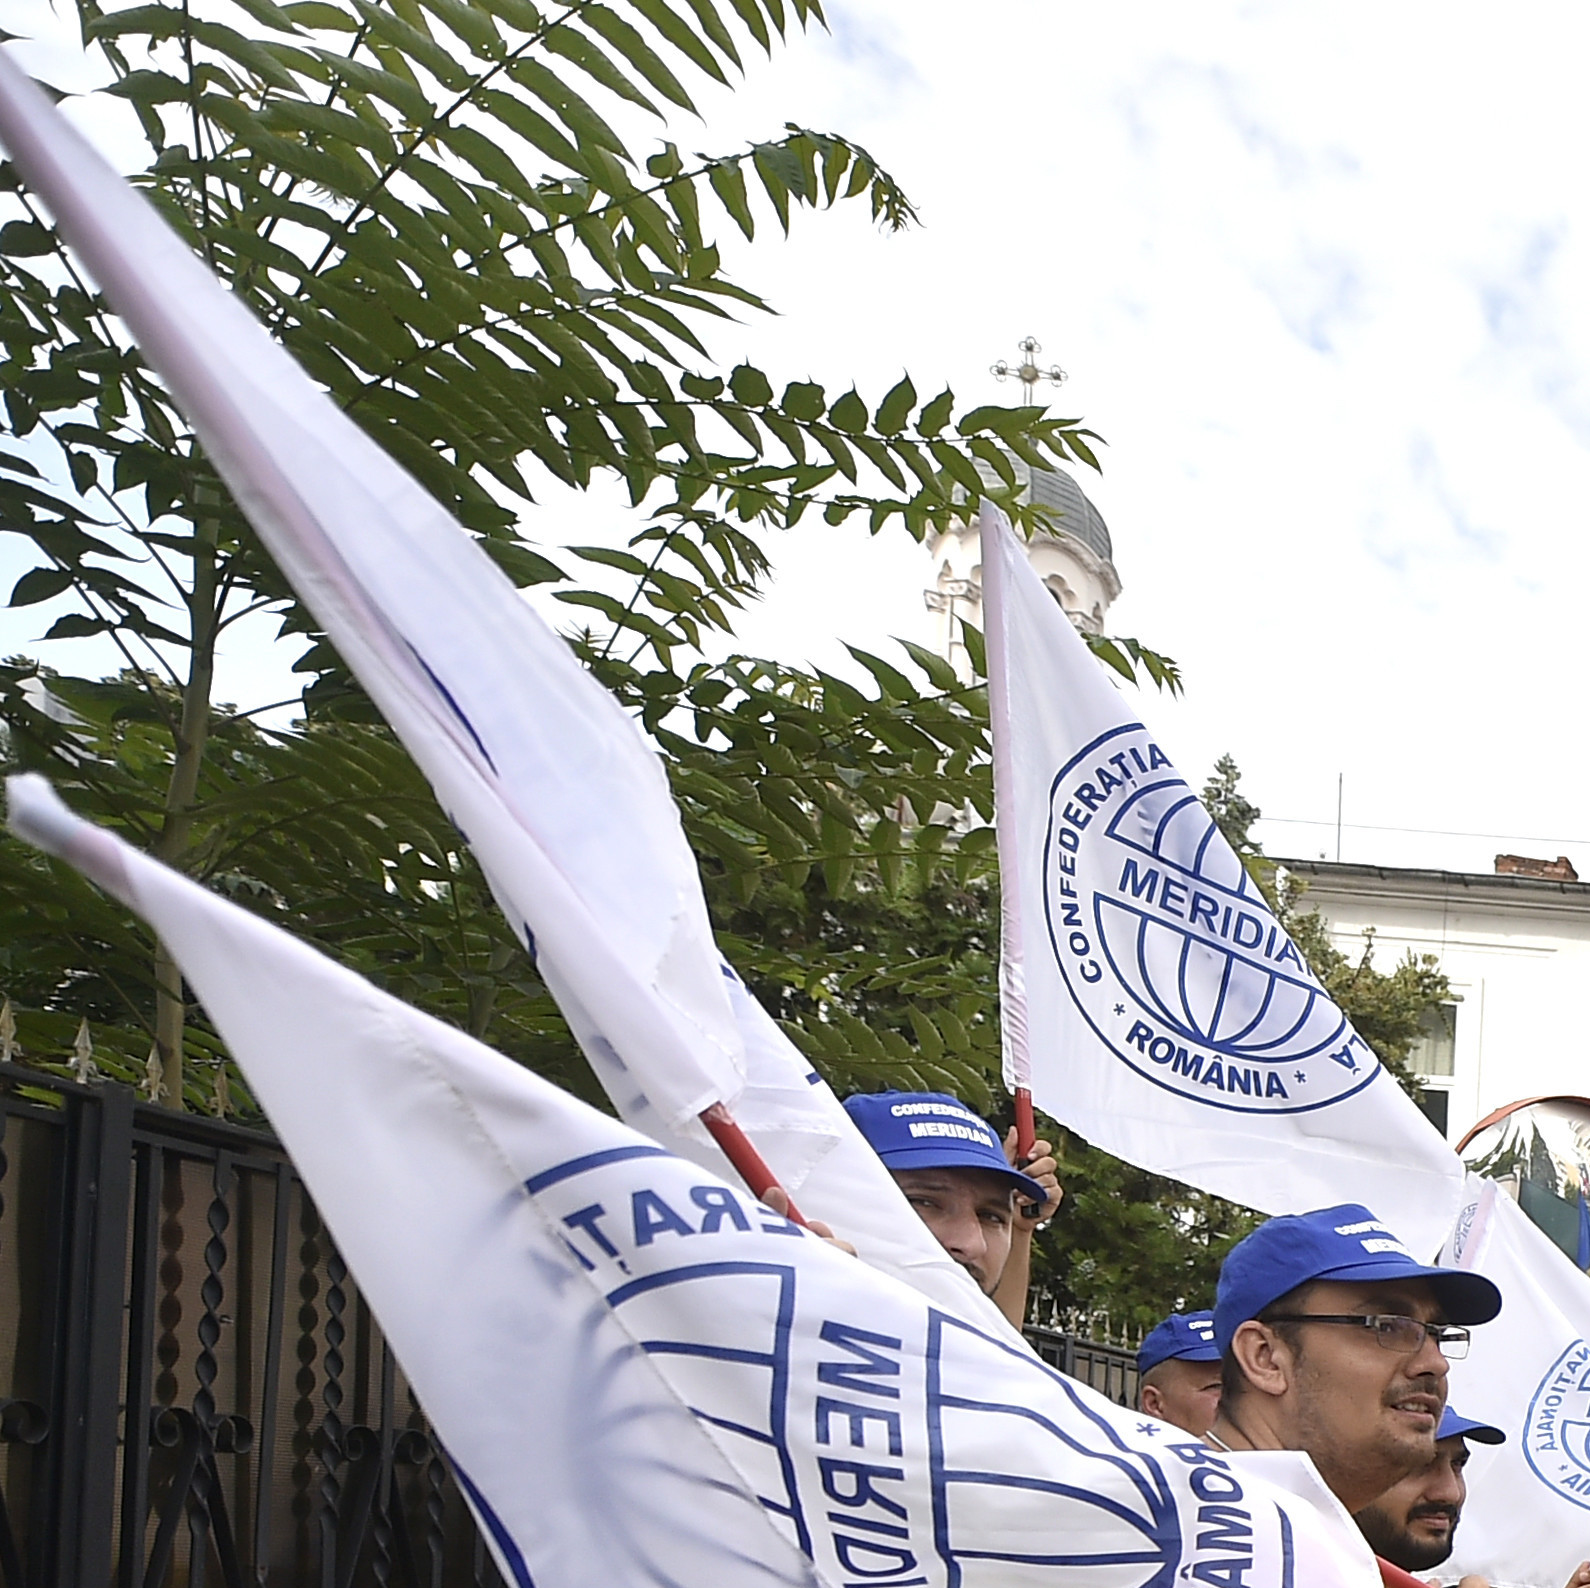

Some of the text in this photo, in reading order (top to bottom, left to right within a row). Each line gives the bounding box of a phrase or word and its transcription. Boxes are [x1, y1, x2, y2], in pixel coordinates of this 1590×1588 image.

[1058, 743, 1173, 984] CONFEDERAȚIA
[1118, 858, 1313, 978] MERIDIA
[1125, 1019, 1289, 1099] ROMÂNIA
